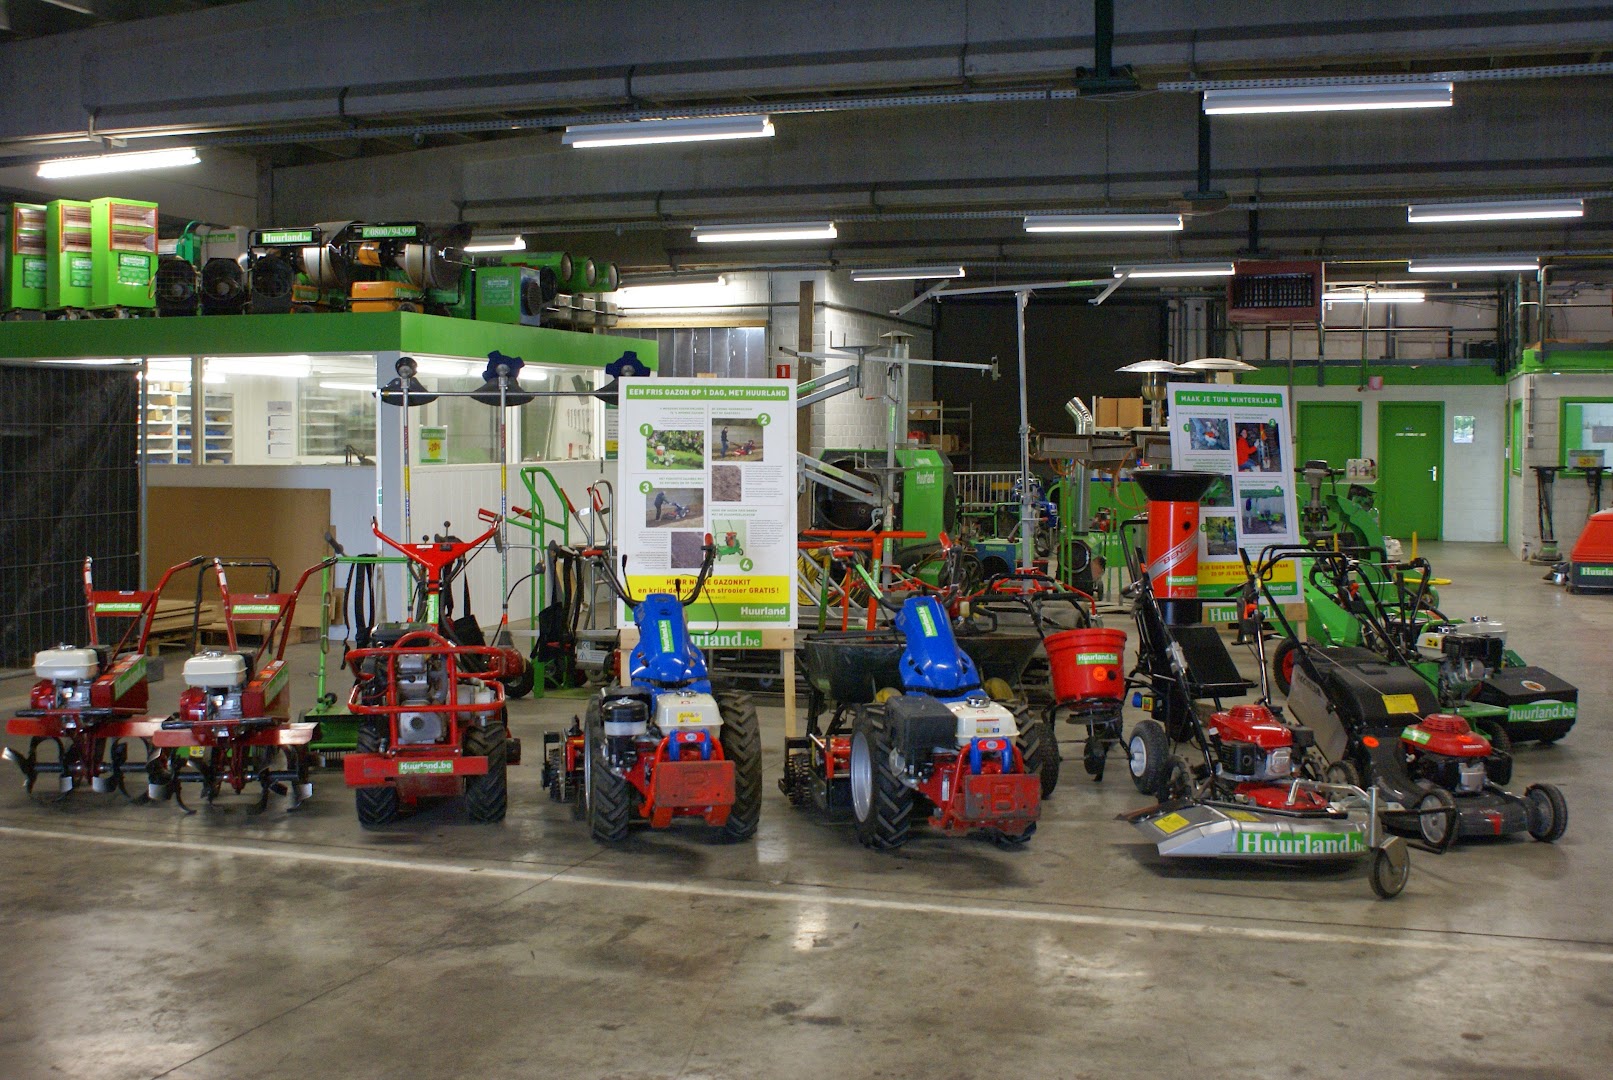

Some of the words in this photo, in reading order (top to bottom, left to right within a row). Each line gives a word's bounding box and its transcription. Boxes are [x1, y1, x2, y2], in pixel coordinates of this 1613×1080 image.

[262, 232, 311, 244] Huurland.be
[629, 388, 644, 396] EEN
[646, 388, 663, 396] FRIS
[665, 388, 689, 396] GAZON
[691, 388, 701, 396] OP
[703, 388, 707, 397] 1
[709, 388, 727, 398] DAG,
[729, 389, 744, 397] MET
[746, 389, 787, 397] HUURLAND
[1202, 395, 1211, 403] JE
[1230, 396, 1278, 404] WINTERKLAAR
[760, 414, 769, 425] 2
[643, 425, 650, 436] 1
[642, 483, 651, 493] 3
[742, 559, 750, 569] 4
[234, 604, 280, 612] Huurland.be
[740, 606, 786, 616] Huurland
[1077, 653, 1118, 662] Huurland.be
[1509, 702, 1576, 721] huurland.be
[400, 761, 453, 771] Huurland.be
[1241, 832, 1367, 854] Huurland.be
